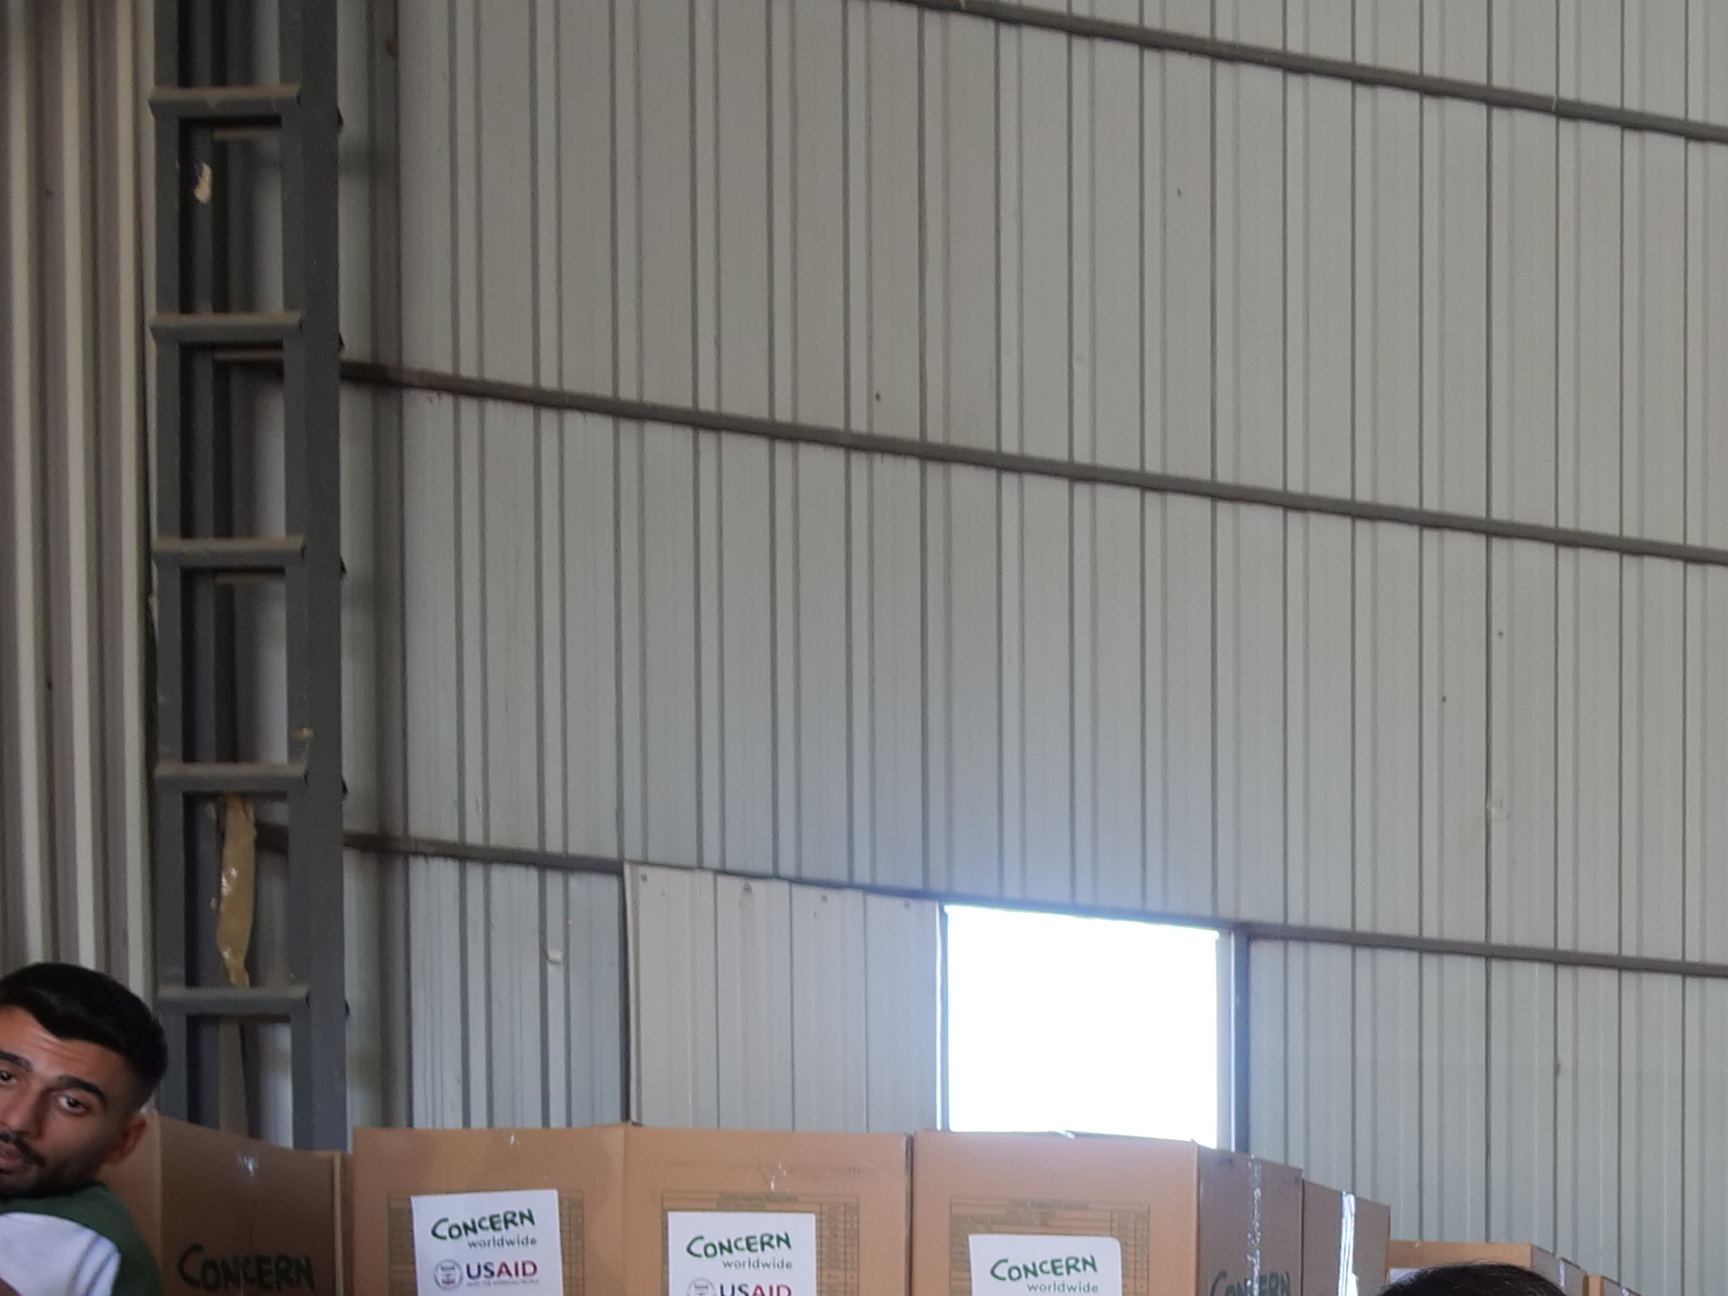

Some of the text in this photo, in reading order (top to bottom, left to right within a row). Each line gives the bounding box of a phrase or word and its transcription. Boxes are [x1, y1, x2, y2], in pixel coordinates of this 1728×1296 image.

[430, 1208, 536, 1240] CONCERN
[467, 1235, 537, 1249] worldwide
[686, 1232, 792, 1258] CONCERN
[177, 1243, 314, 1291] CONCERN
[466, 1260, 538, 1280] USAID
[722, 1257, 793, 1270] worldwide
[990, 1255, 1098, 1281] CONCERN
[1027, 1281, 1098, 1293] worldwide
